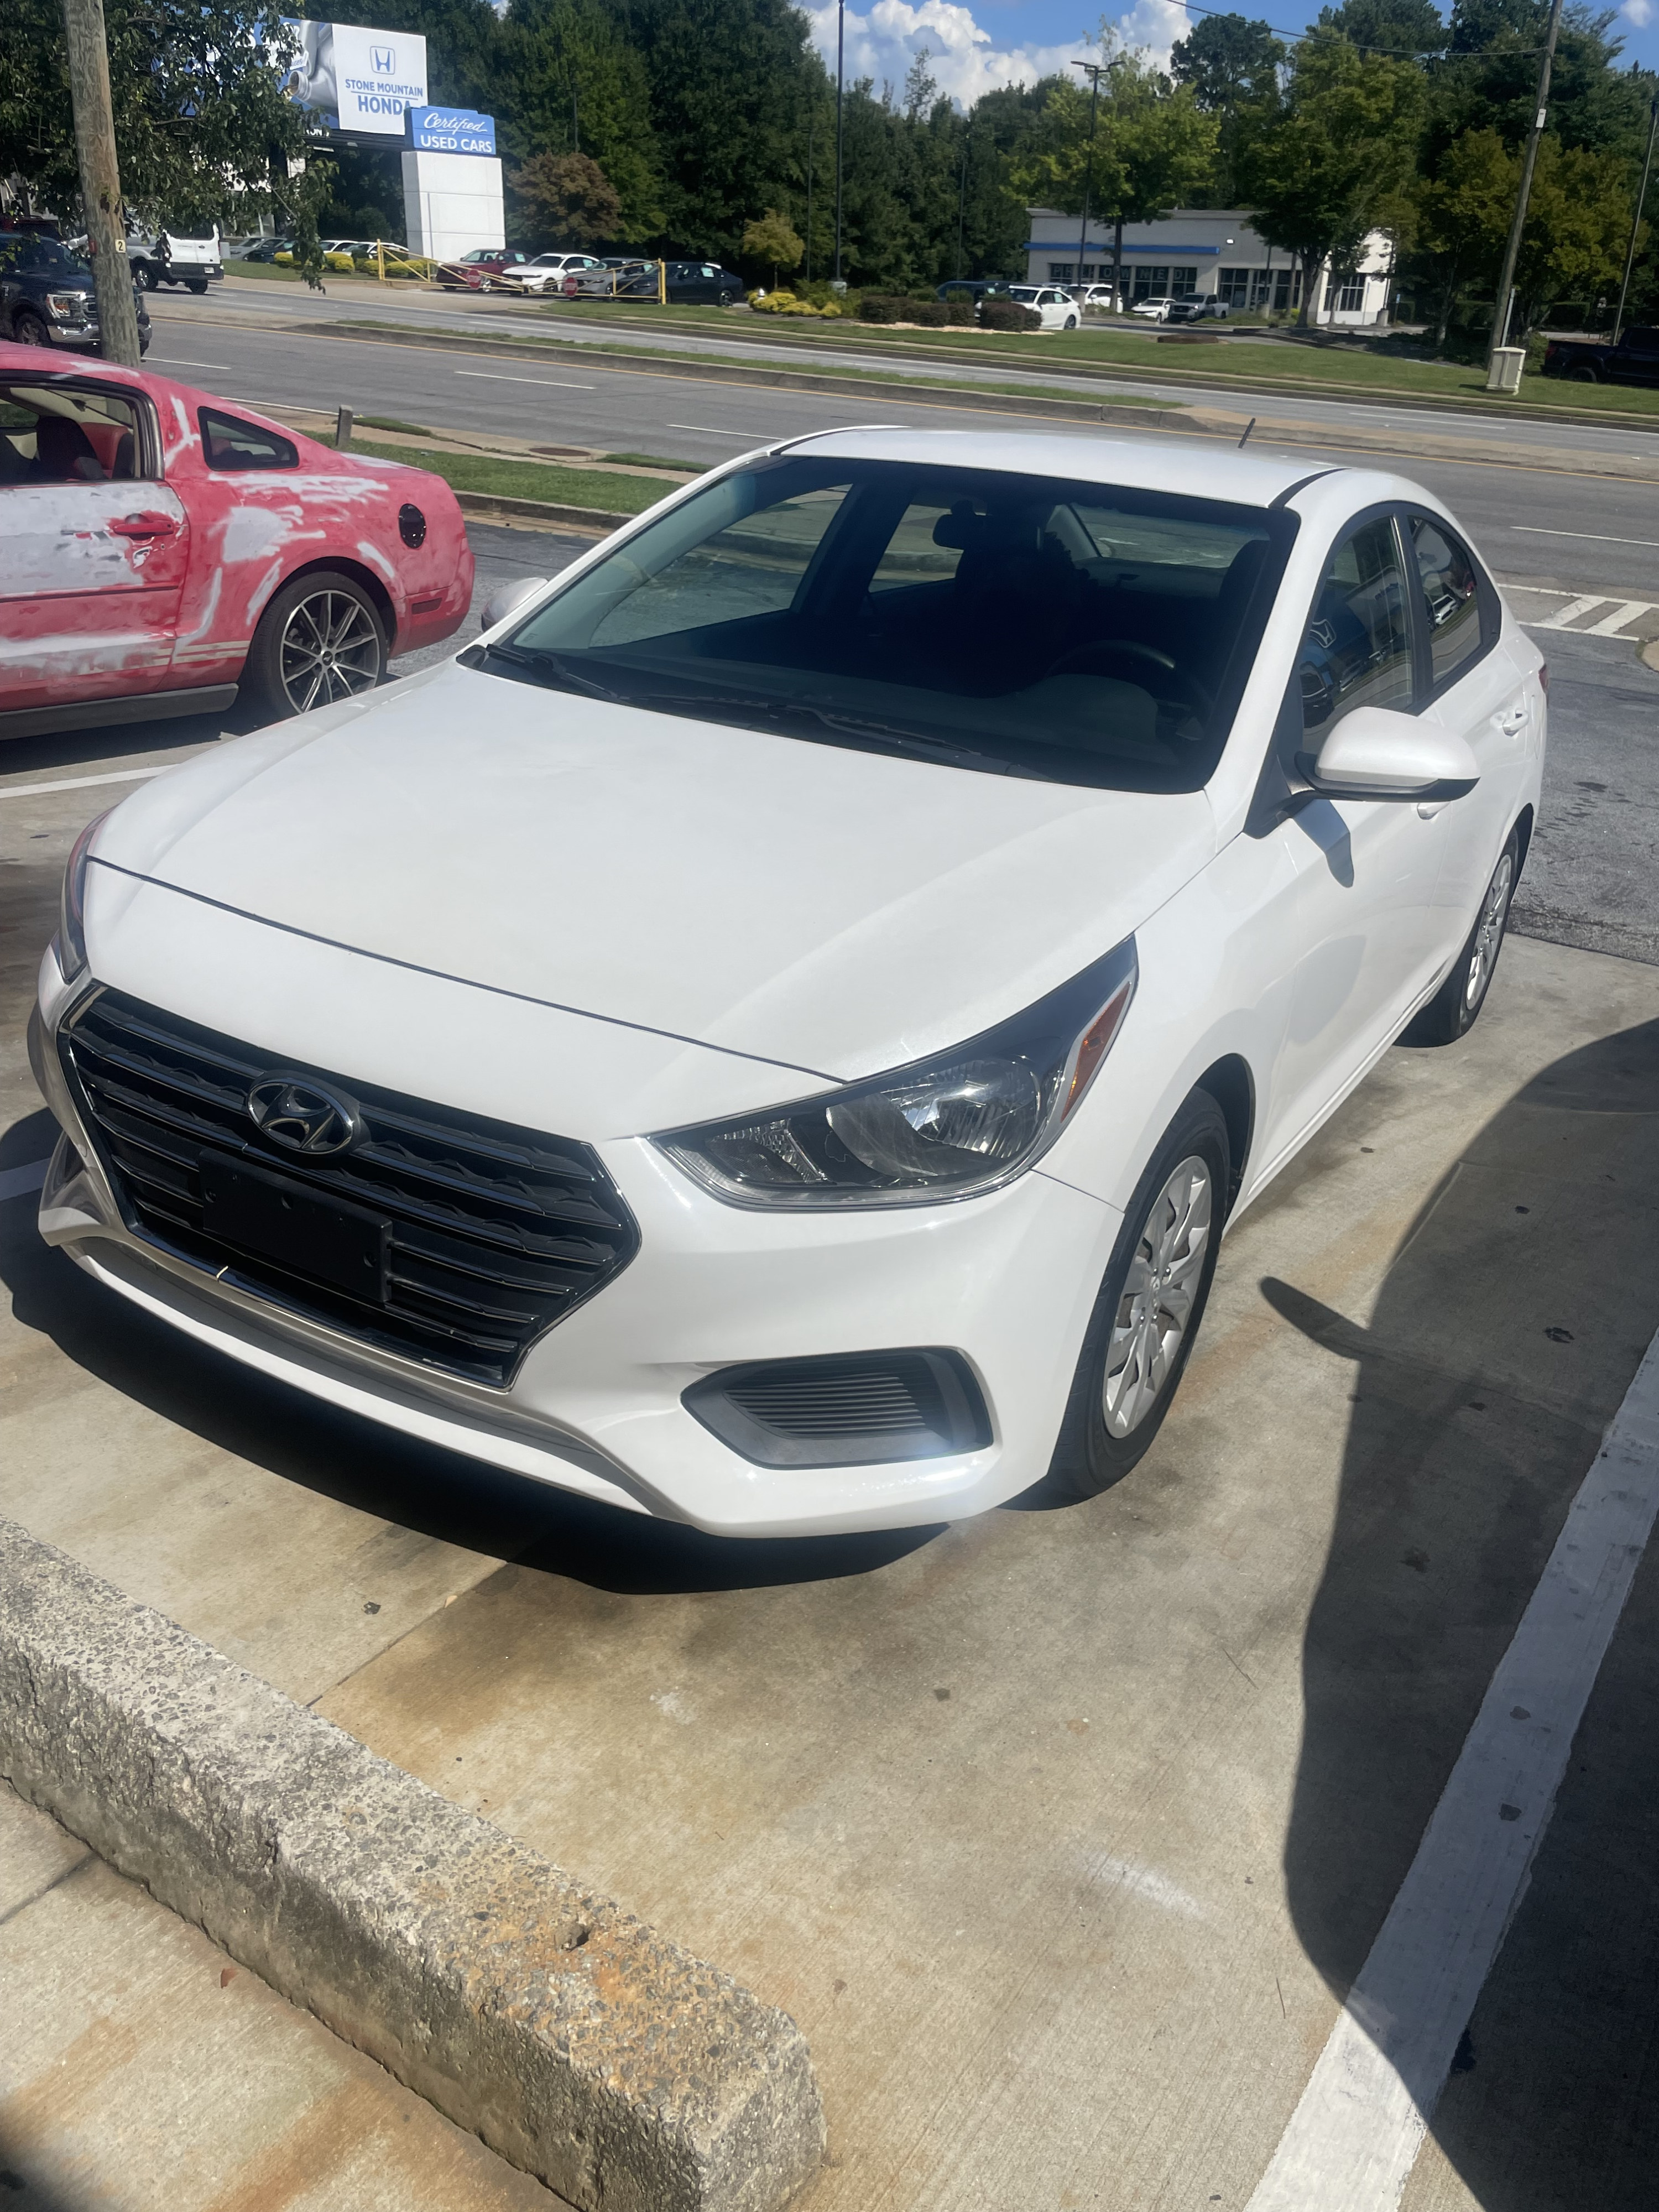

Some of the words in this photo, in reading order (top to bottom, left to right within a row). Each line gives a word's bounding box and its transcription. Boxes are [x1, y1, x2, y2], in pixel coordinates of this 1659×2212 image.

[345, 79, 375, 92] STONE
[377, 82, 423, 97] MOUNTAIN
[424, 113, 488, 135] Certified
[420, 135, 457, 150] USED
[461, 139, 492, 153] CARS
[118, 241, 123, 251] 2
